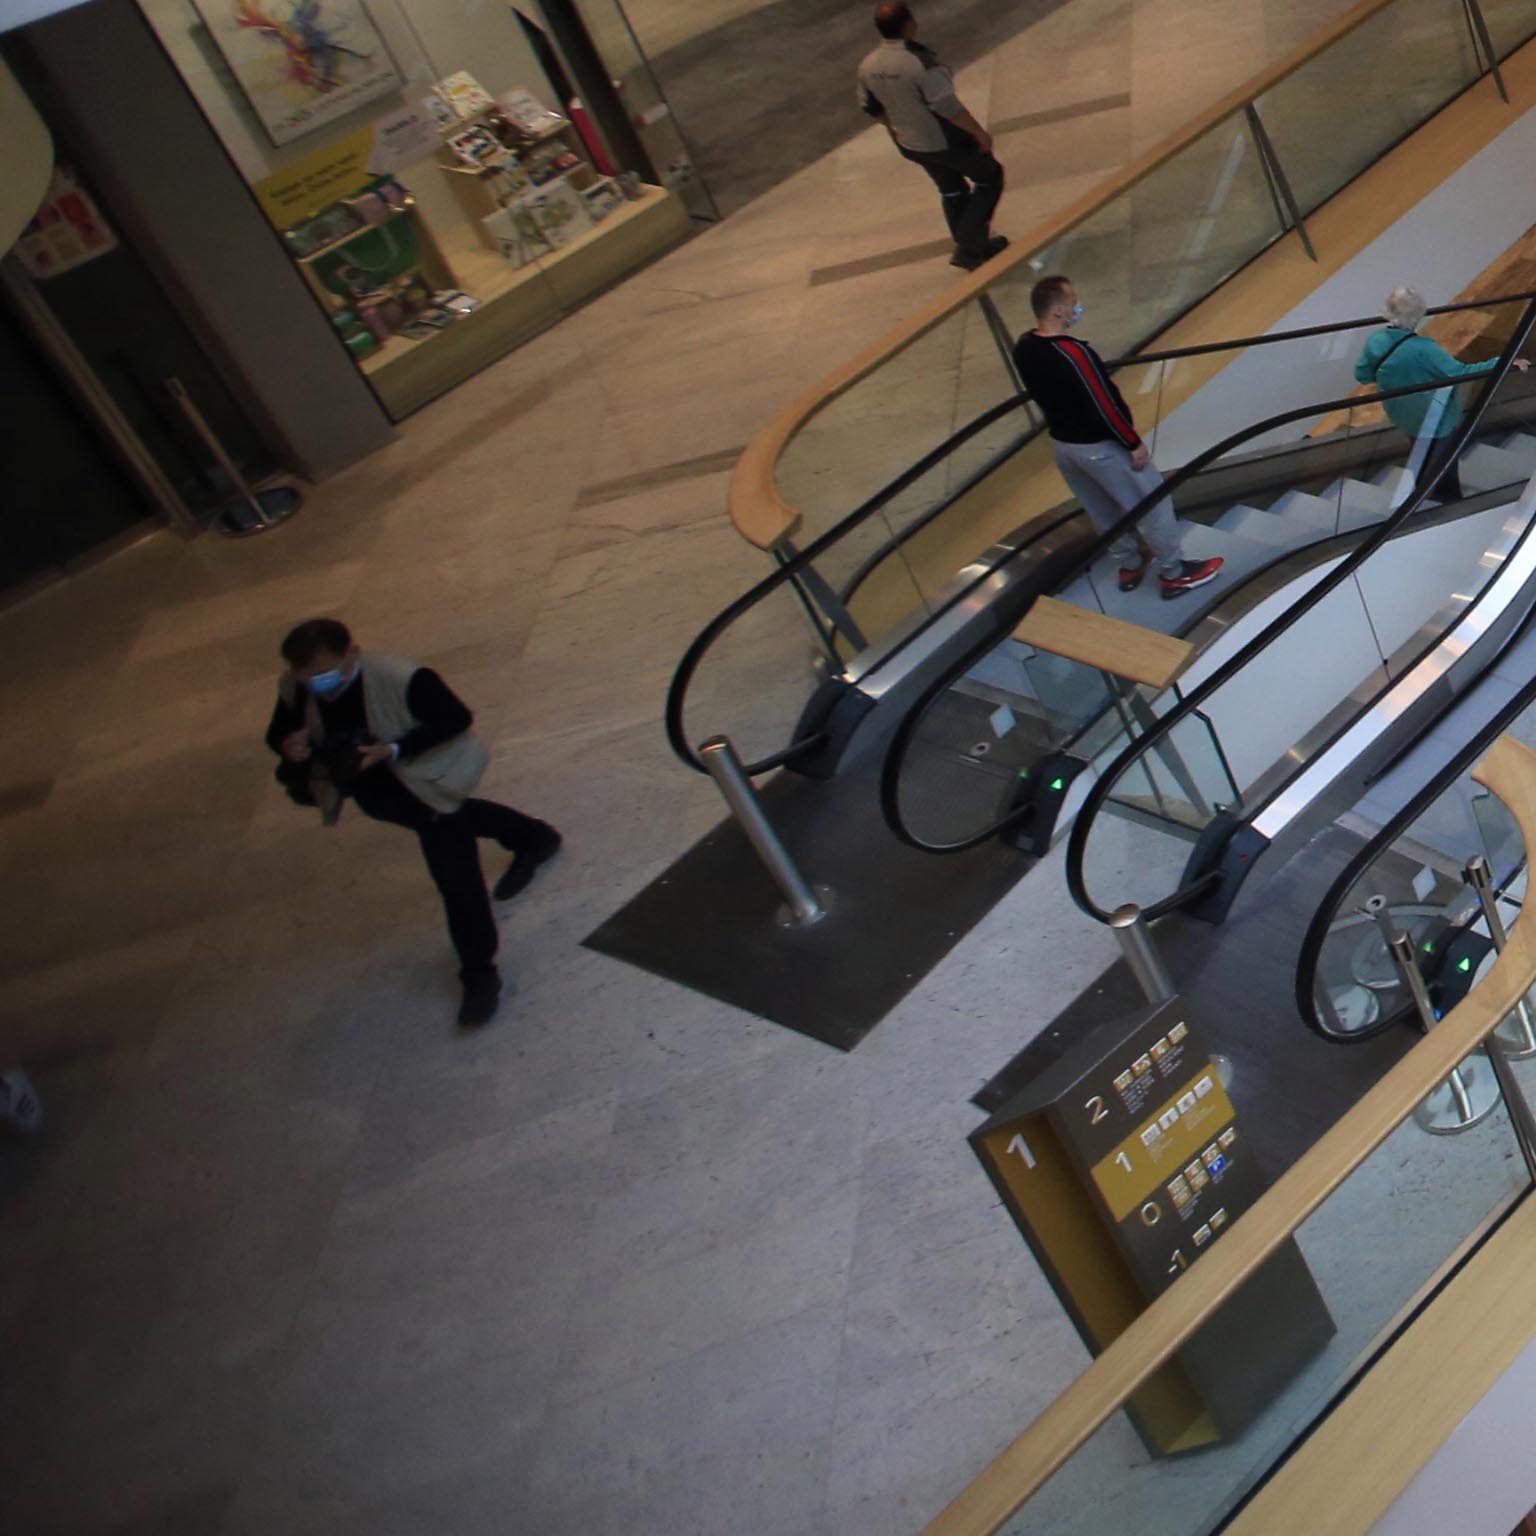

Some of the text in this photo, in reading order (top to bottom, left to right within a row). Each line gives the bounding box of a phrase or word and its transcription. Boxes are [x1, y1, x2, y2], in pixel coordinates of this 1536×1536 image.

[1084, 1095, 1110, 1126] 2
[1006, 1132, 1037, 1170] 1
[1114, 1151, 1134, 1173] 1
[1140, 1201, 1162, 1228] 0
